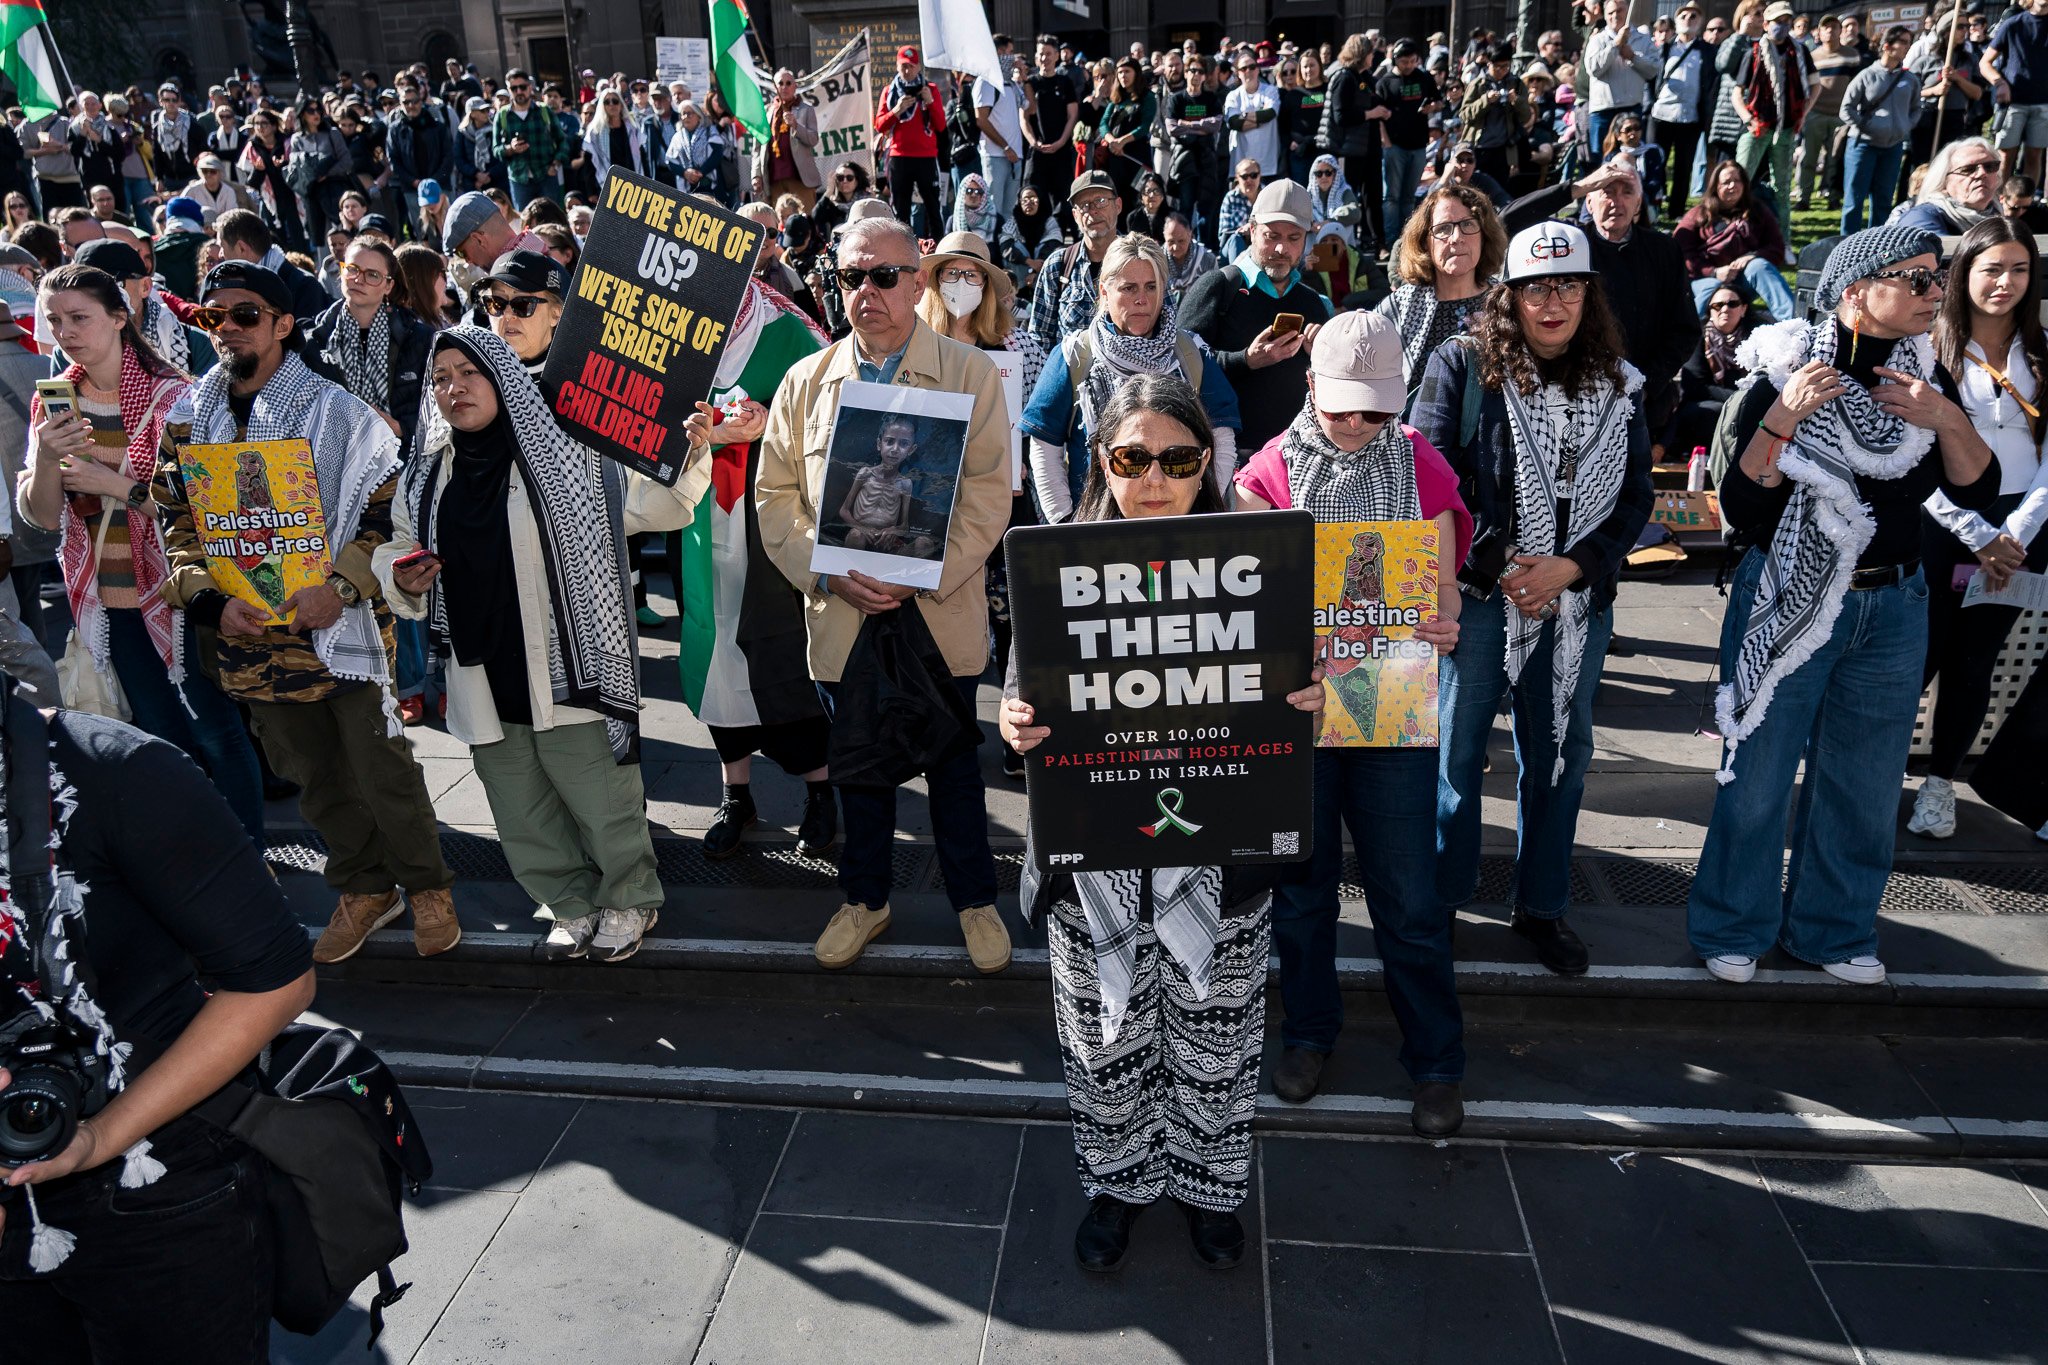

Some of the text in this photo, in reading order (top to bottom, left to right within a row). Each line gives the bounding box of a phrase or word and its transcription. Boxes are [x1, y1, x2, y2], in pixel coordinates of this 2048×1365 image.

[821, 65, 866, 103] BAY
[606, 175, 756, 264] YOU'RE SICK OF
[637, 233, 699, 292] US?
[578, 263, 726, 355] WE'RE SICK OF
[600, 311, 681, 374] 'ISRAEL'
[579, 350, 665, 419] KILLING
[555, 380, 668, 462] CHILDREN!
[205, 509, 308, 531] Palestine
[204, 536, 324, 557] will be Free
[1059, 555, 1262, 607] BRING
[1313, 603, 1420, 626] alestine
[1067, 610, 1256, 659] THEM
[1333, 637, 1367, 659] be
[1372, 637, 1433, 659] Free
[1068, 663, 1263, 712] HOME
[1104, 726, 1231, 745] OVER 10,000
[1411, 736, 1436, 745] FPP
[1044, 742, 1294, 767] PALESTINIAN HOSTAGES
[1089, 763, 1249, 783] HELD IN ISRAEL
[1049, 853, 1084, 865] FPP
[21, 1043, 52, 1054] Canon
